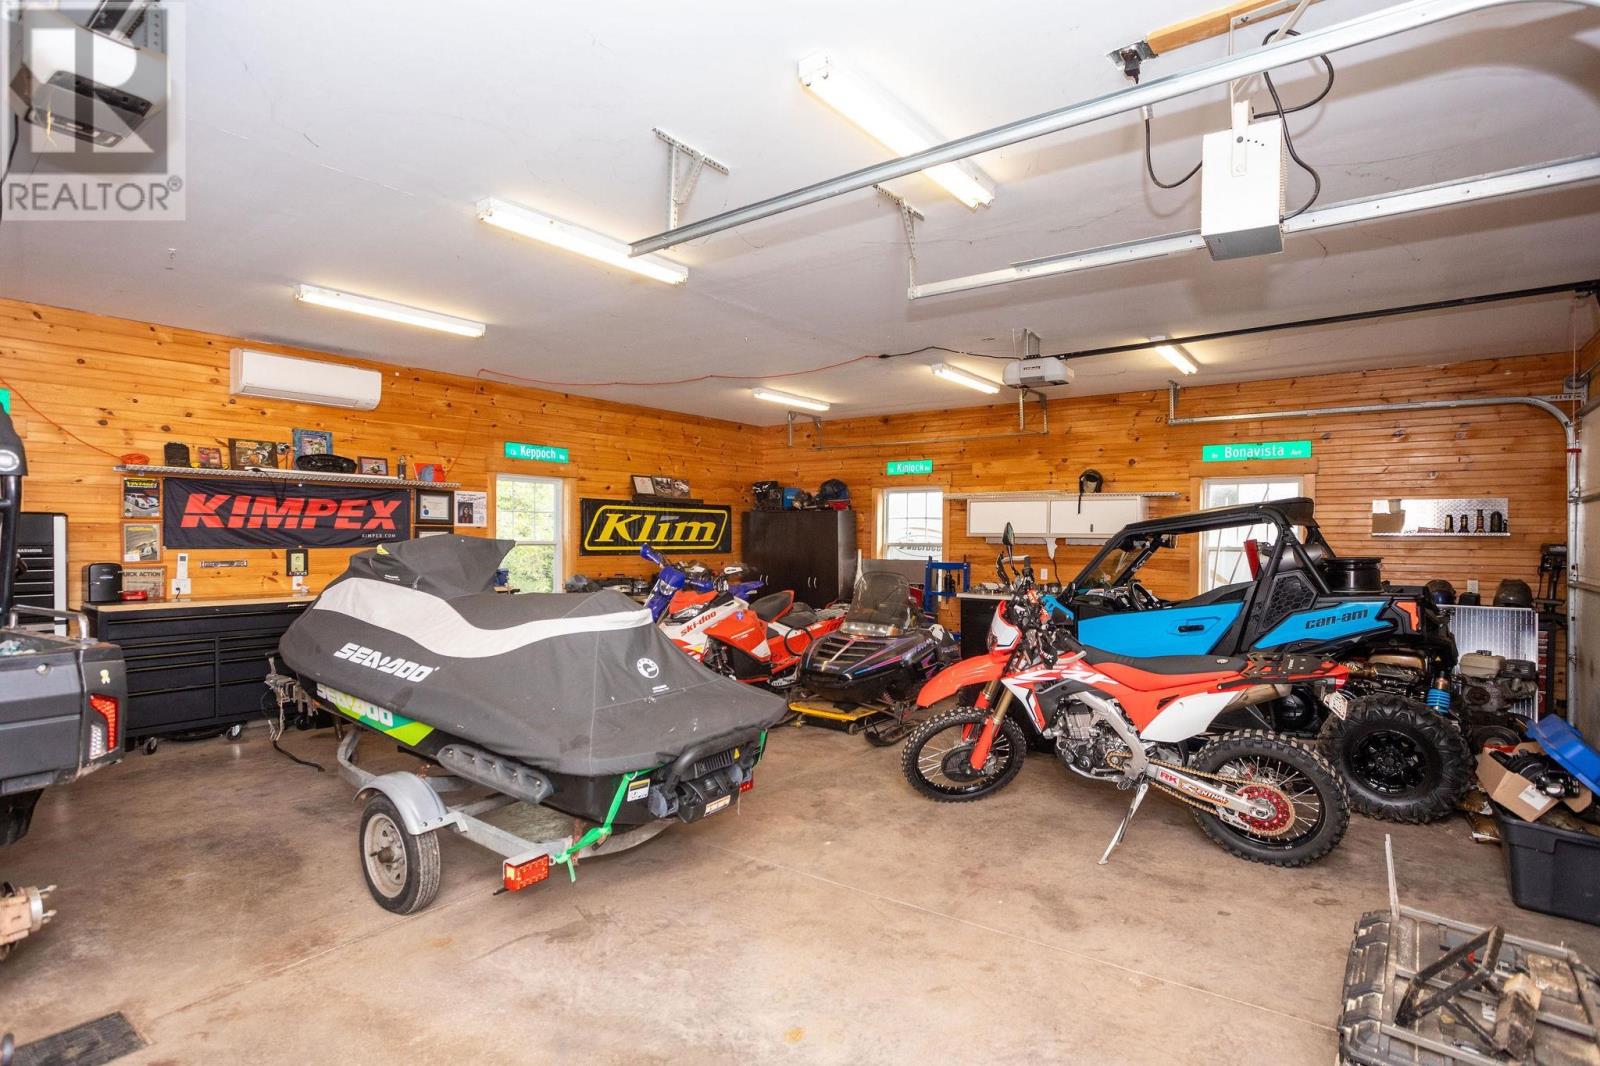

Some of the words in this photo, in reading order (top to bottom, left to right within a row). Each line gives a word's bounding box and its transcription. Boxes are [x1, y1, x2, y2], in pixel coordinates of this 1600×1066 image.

[520, 445, 556, 460] Keppoch
[1224, 446, 1284, 458] Bonavista
[180, 493, 402, 530] KIMPEX
[594, 513, 717, 542] Klim
[680, 610, 718, 637] ski-doo
[1305, 608, 1369, 630] can-am
[1160, 771, 1178, 785] RK
